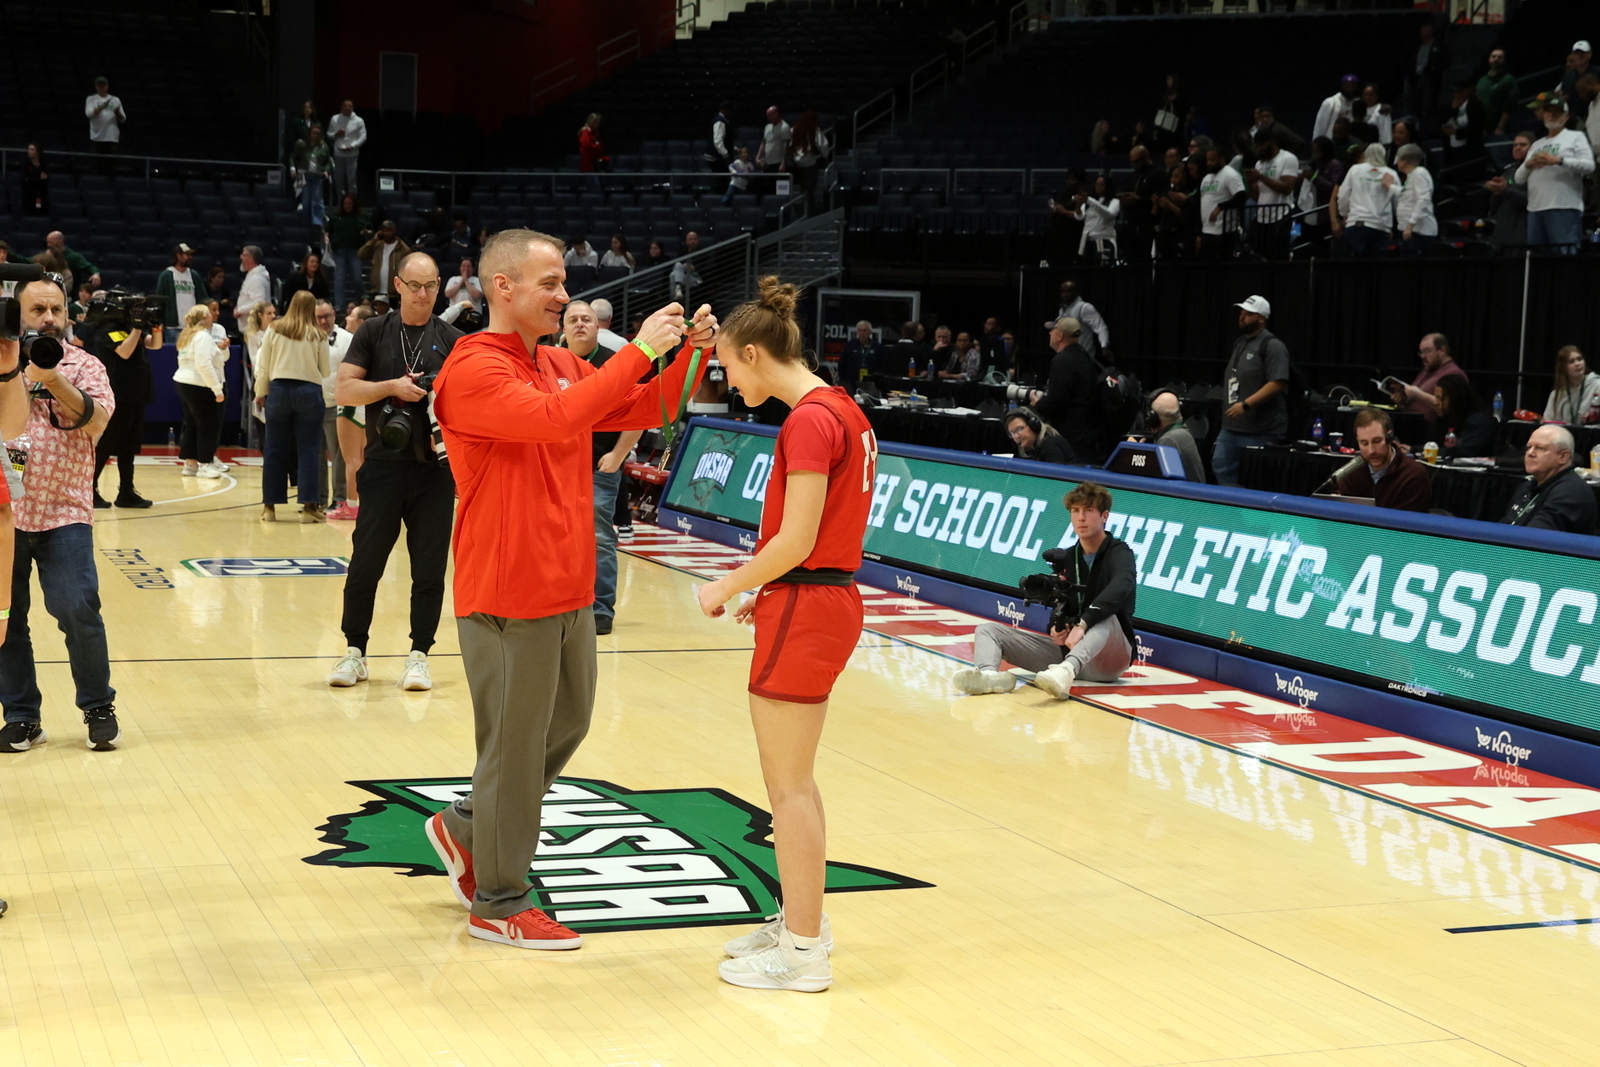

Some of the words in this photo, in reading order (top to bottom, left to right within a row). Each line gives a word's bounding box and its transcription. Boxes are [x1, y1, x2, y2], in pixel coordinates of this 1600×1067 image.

[693, 451, 734, 487] OHSAA
[1131, 454, 1146, 467] POSS
[893, 479, 1048, 561] SCHOOL
[1004, 601, 1026, 626] Kroger
[1287, 675, 1319, 708] Kroger
[1388, 682, 1428, 698] DAKTRONICS
[1491, 730, 1532, 767] Kroger
